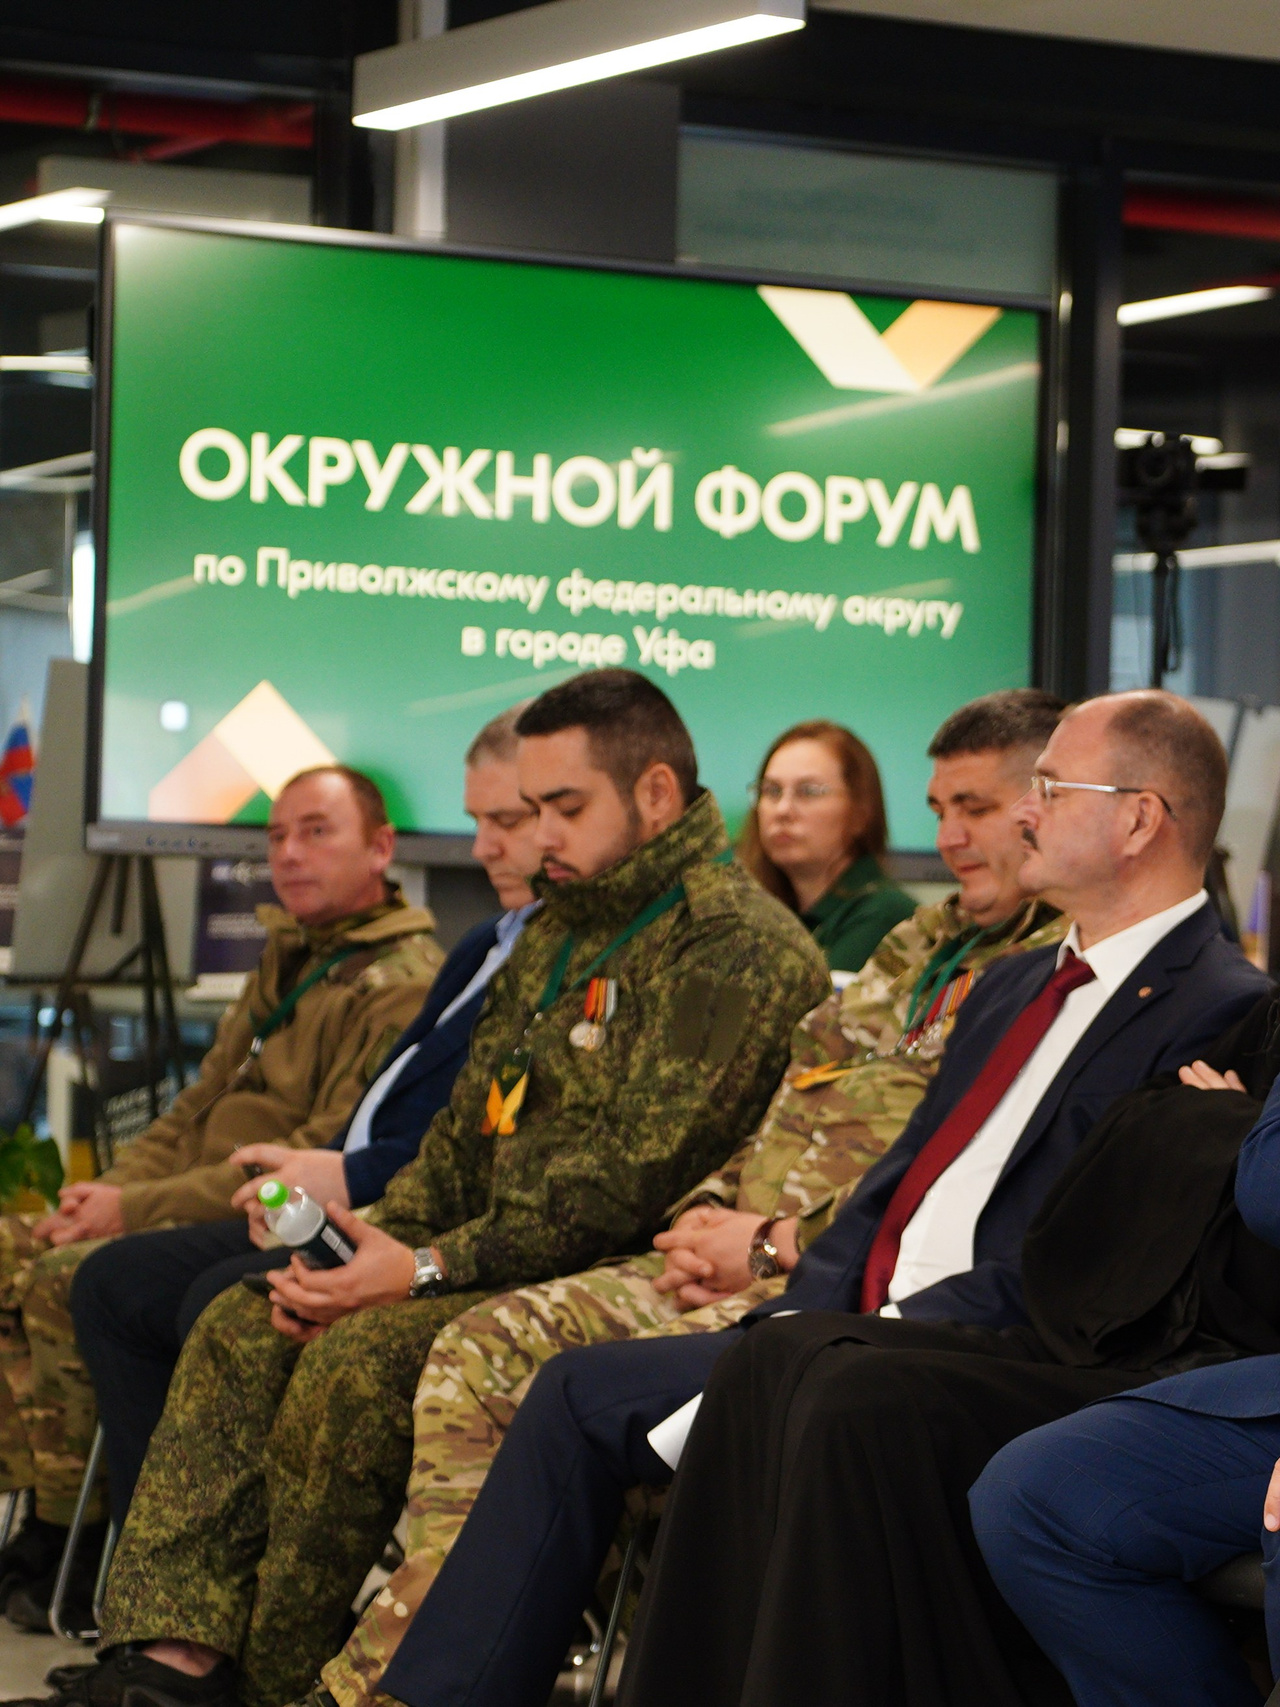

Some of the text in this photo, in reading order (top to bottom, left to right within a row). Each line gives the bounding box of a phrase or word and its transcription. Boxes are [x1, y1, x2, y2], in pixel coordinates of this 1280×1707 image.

[178, 427, 981, 554] ОКРУЖНОЙ ФОРУМ
[193, 546, 964, 640] по Приволжскому федеральному округу
[461, 624, 716, 677] в городе Уфа
